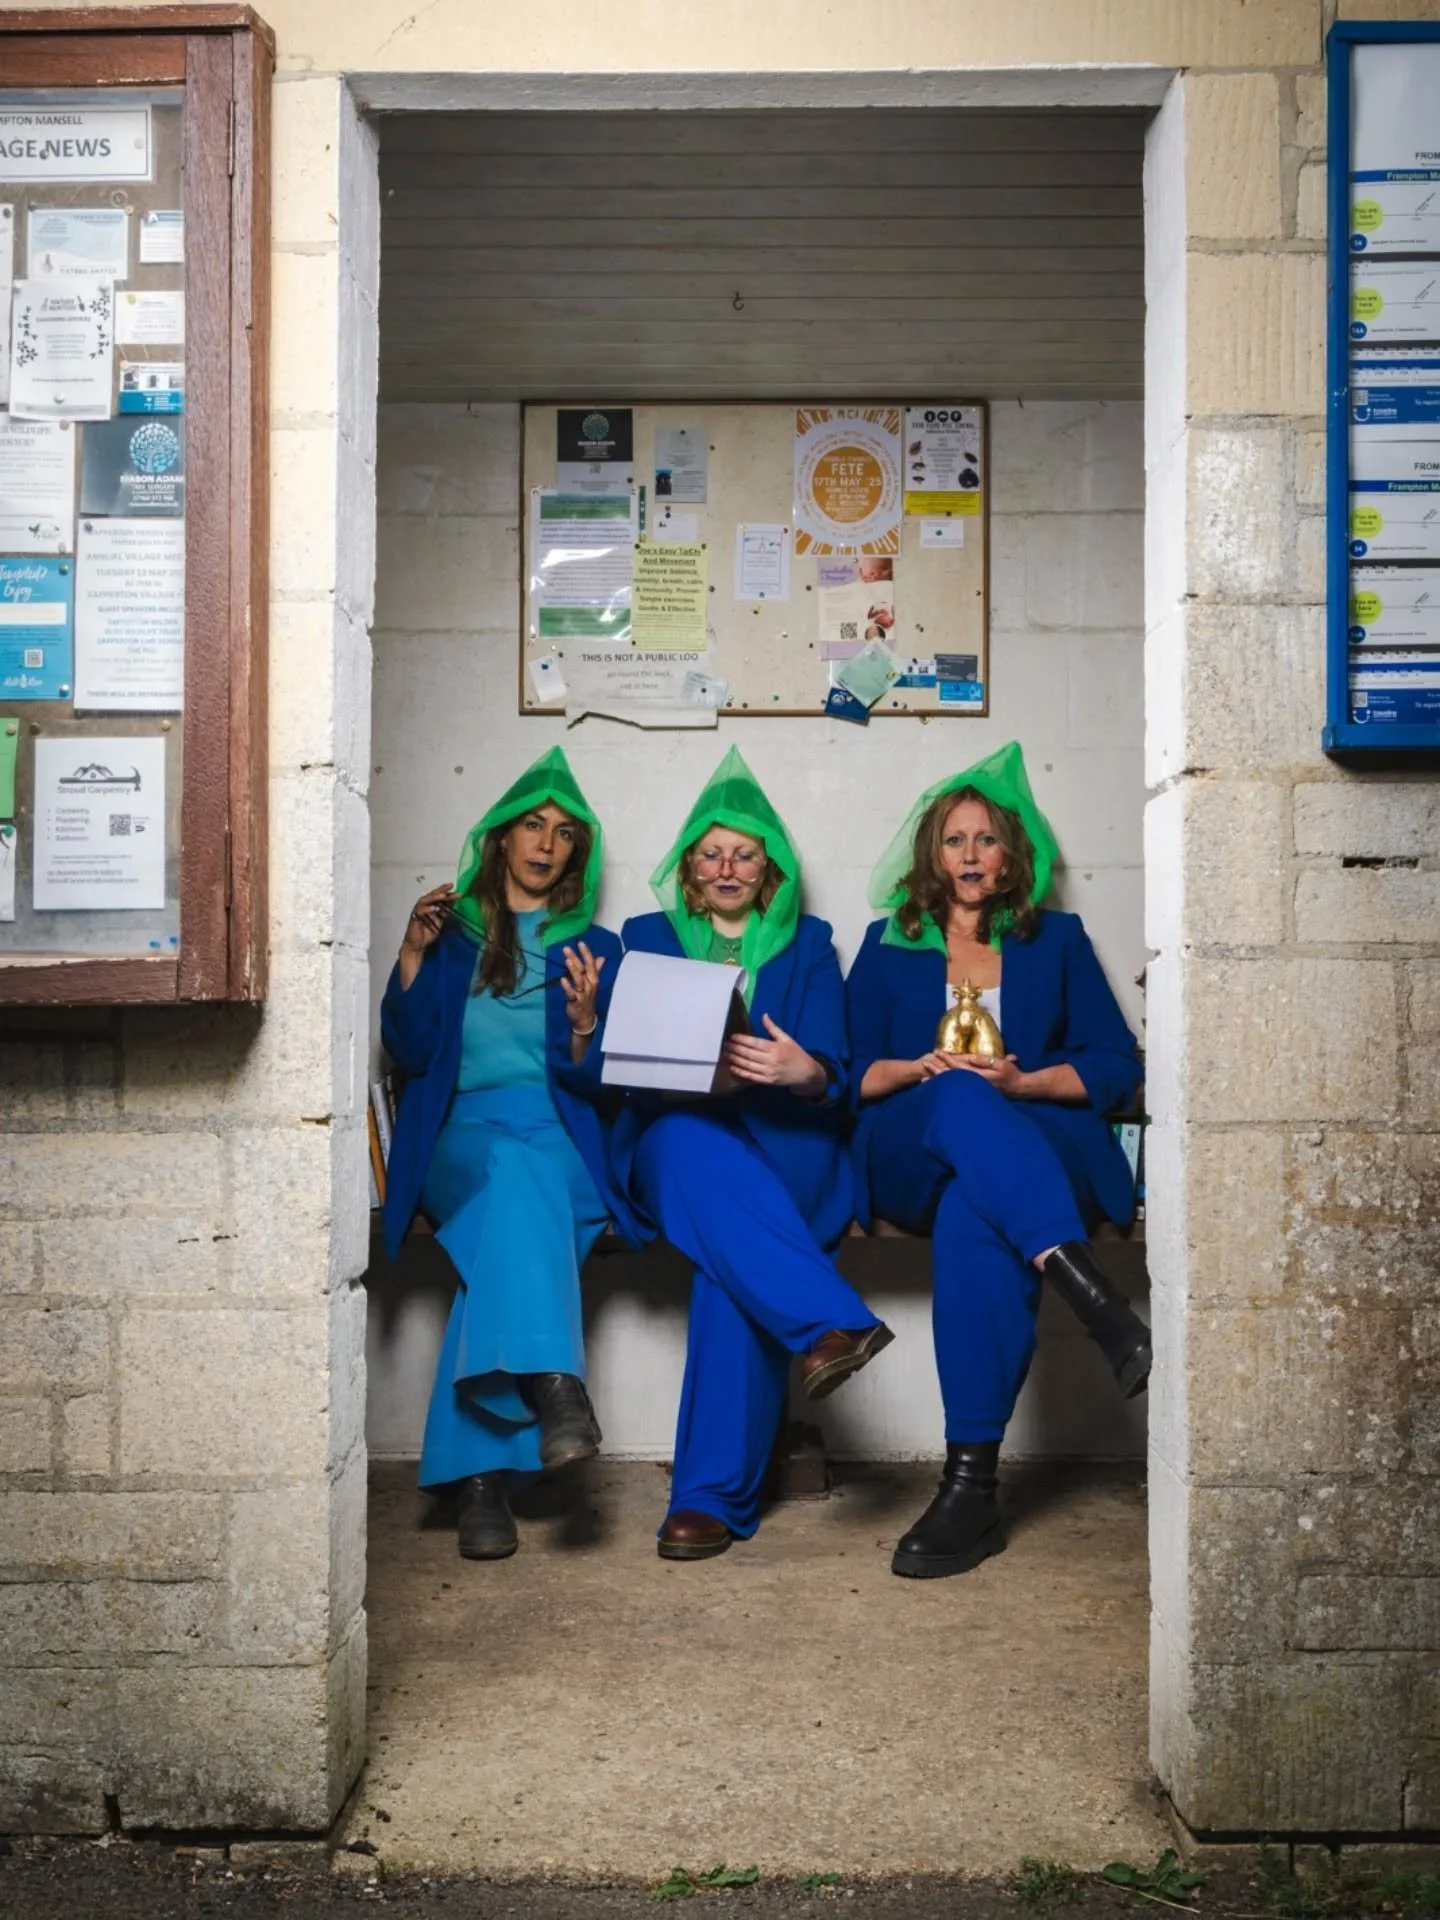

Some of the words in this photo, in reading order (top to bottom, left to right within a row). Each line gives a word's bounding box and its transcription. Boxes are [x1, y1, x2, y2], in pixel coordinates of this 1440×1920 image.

[35, 116, 84, 125] MANSELL
[45, 138, 112, 157] NEWS
[1387, 171, 1428, 182] Frampton
[831, 463, 865, 476] FETE
[814, 477, 836, 487] 17TH
[840, 477, 861, 487] MAY
[1388, 482, 1429, 492] Frampton
[642, 557, 658, 565] And
[660, 557, 696, 565] Movement
[582, 654, 602, 662] THIS
[604, 654, 613, 662] IS
[615, 654, 633, 662] NOT
[645, 653, 678, 662] PUBLIC
[679, 653, 699, 661] LOO
[57, 786, 86, 794] Stroud
[88, 786, 131, 796] Carpentry
